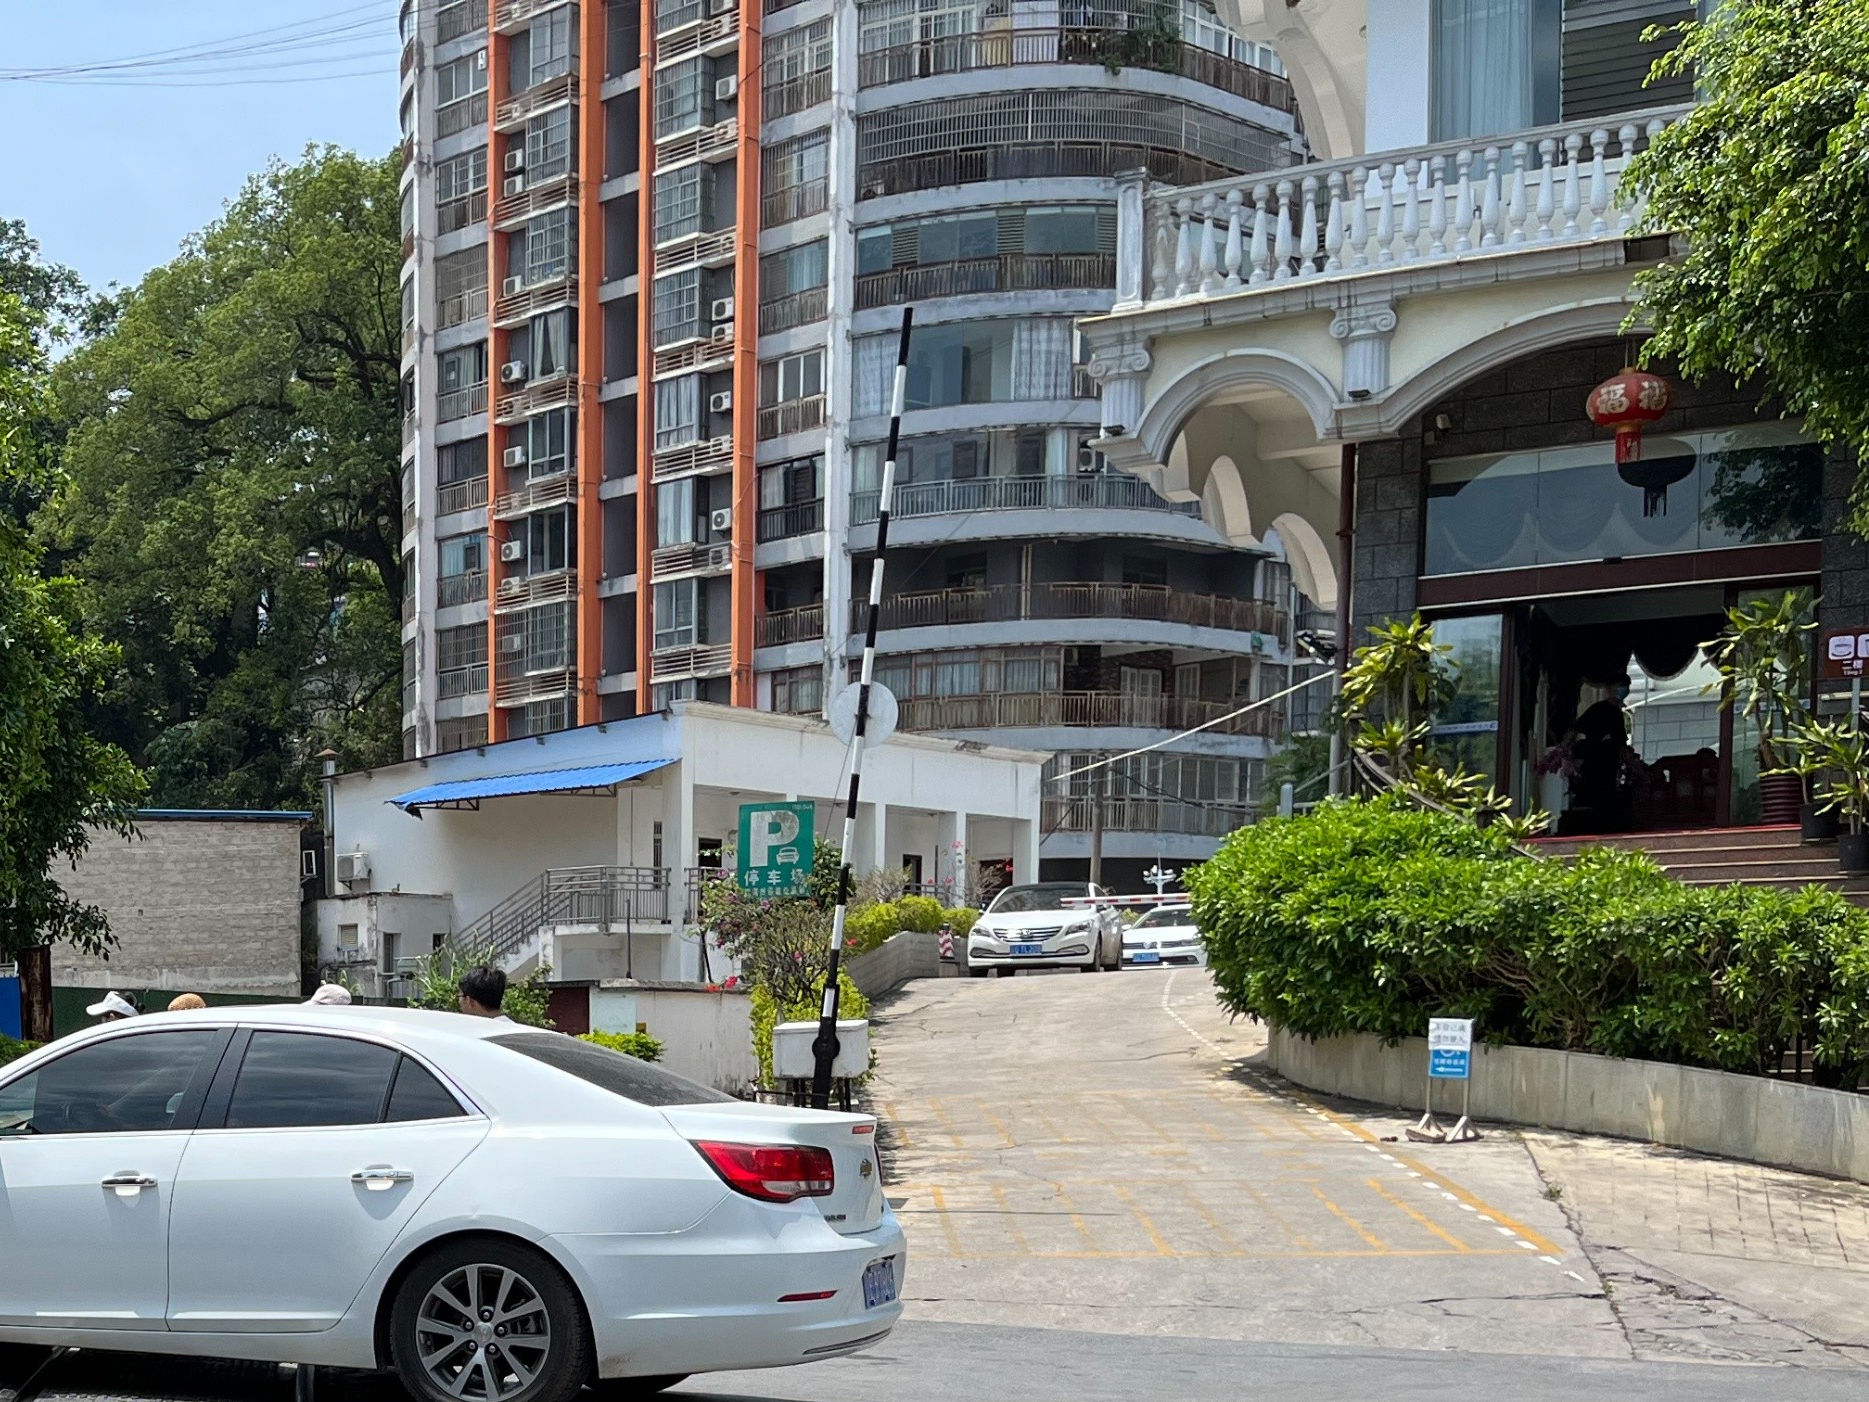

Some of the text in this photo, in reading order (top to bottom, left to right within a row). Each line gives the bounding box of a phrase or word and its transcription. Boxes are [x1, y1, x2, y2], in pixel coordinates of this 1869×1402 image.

[750, 810, 799, 867] P
[744, 869, 803, 886] 停车场
